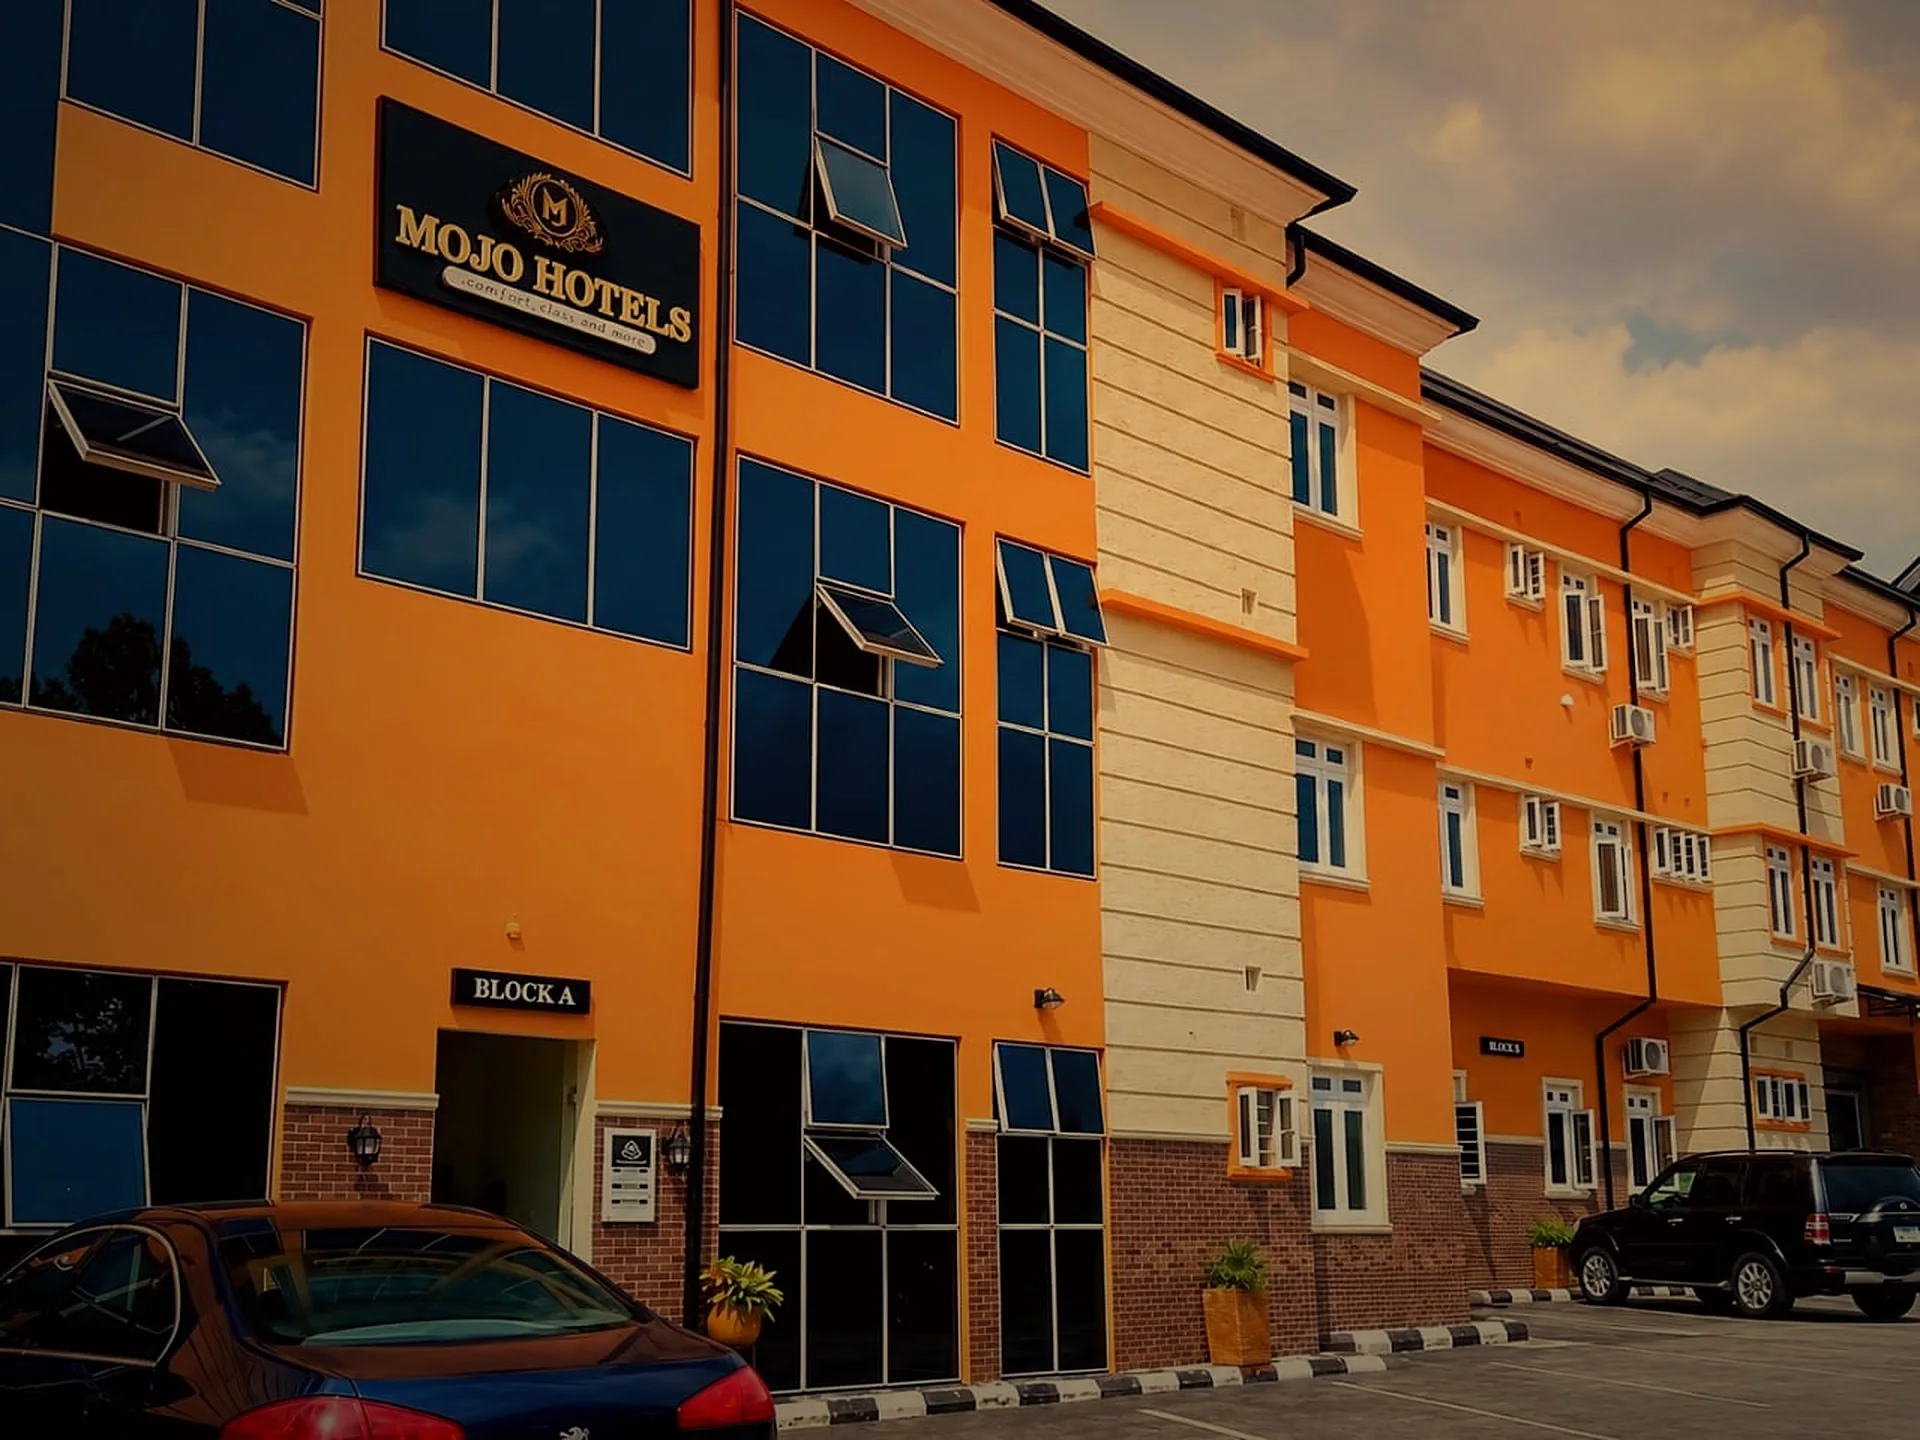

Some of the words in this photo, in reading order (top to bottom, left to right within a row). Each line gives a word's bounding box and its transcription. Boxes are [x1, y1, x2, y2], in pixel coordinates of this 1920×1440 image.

[395, 205, 524, 283] MOJO
[532, 255, 692, 343] HOTELS
[539, 303, 575, 324] class
[580, 318, 606, 334] and
[612, 329, 646, 348] more
[473, 978, 555, 1005] BLOCK
[558, 985, 576, 1006] A
